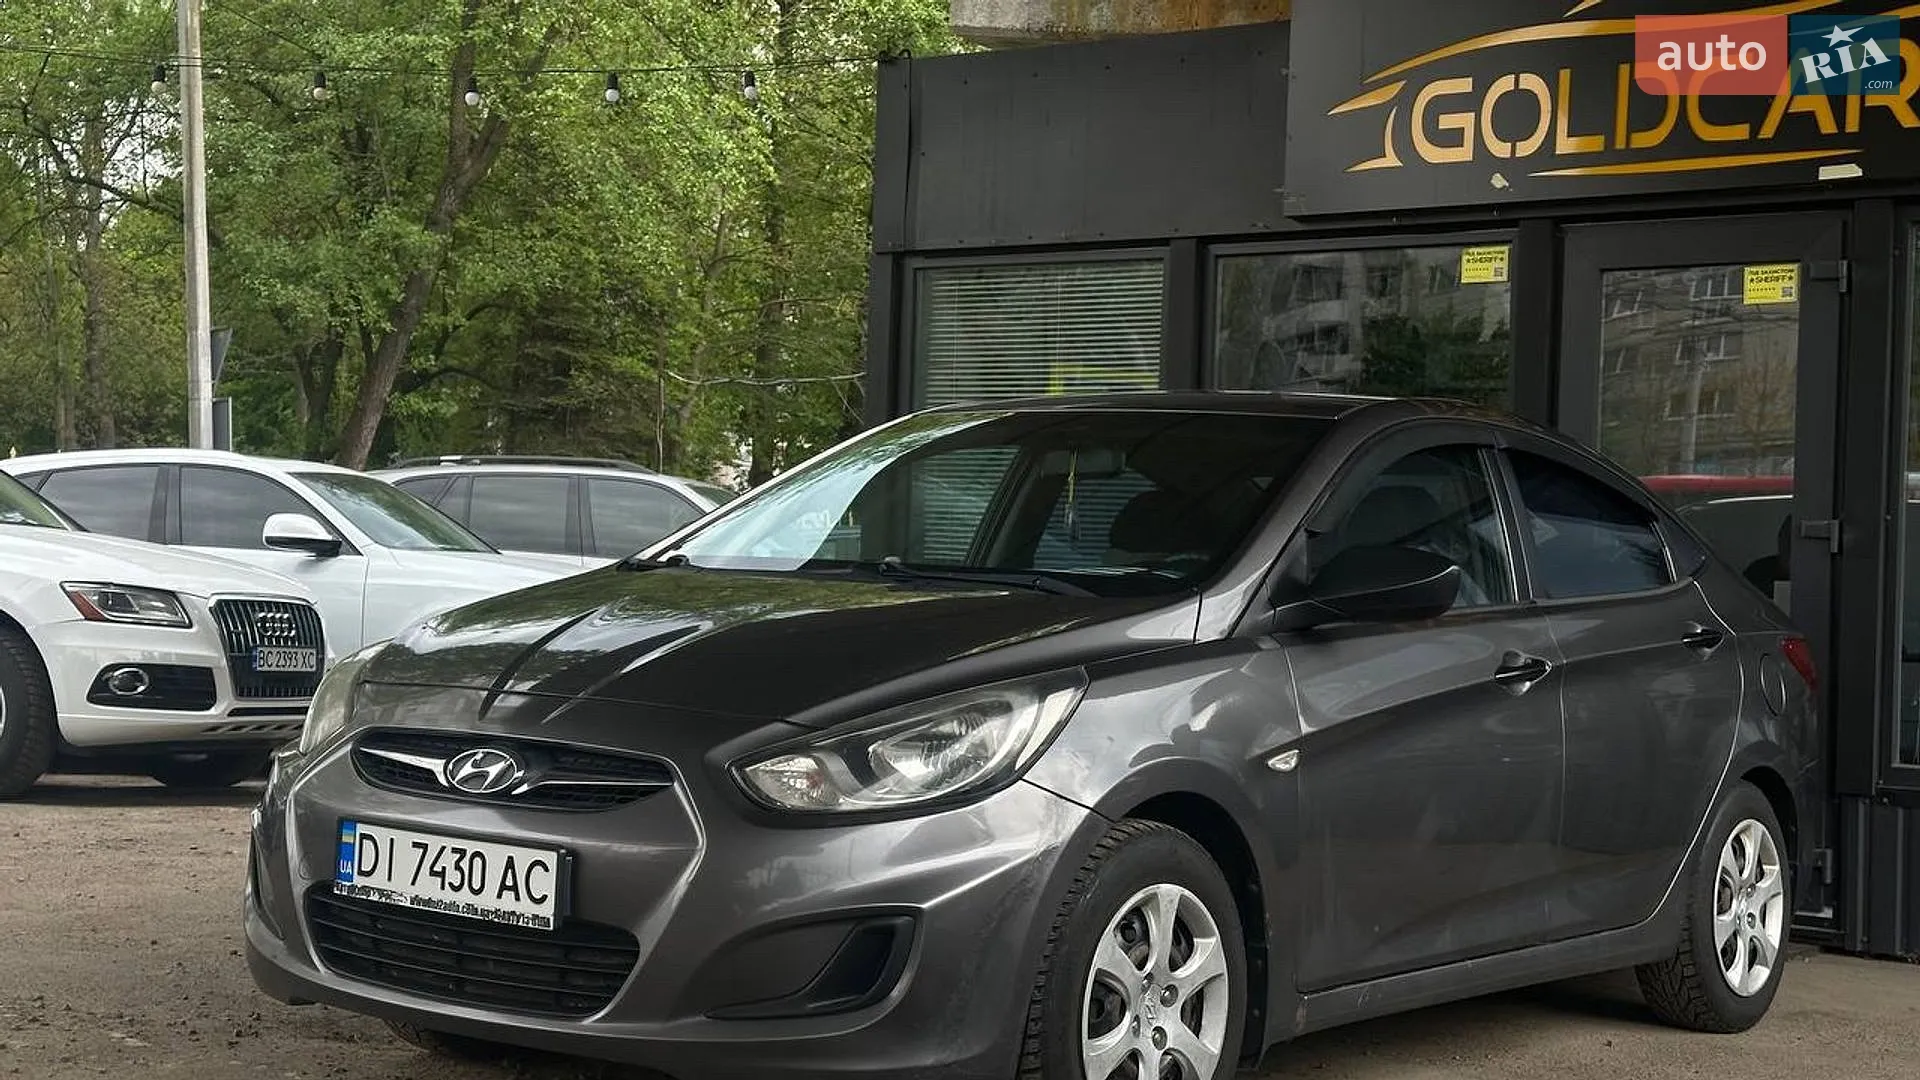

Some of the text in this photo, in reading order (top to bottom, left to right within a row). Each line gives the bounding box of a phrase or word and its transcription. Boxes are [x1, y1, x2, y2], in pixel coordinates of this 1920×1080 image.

[258, 650, 273, 668] BC
[275, 651, 298, 668] 2393
[301, 652, 315, 669] XC
[339, 859, 352, 875] UA
[357, 832, 395, 882] DI
[411, 841, 487, 896] 7430
[496, 855, 550, 905] AC
